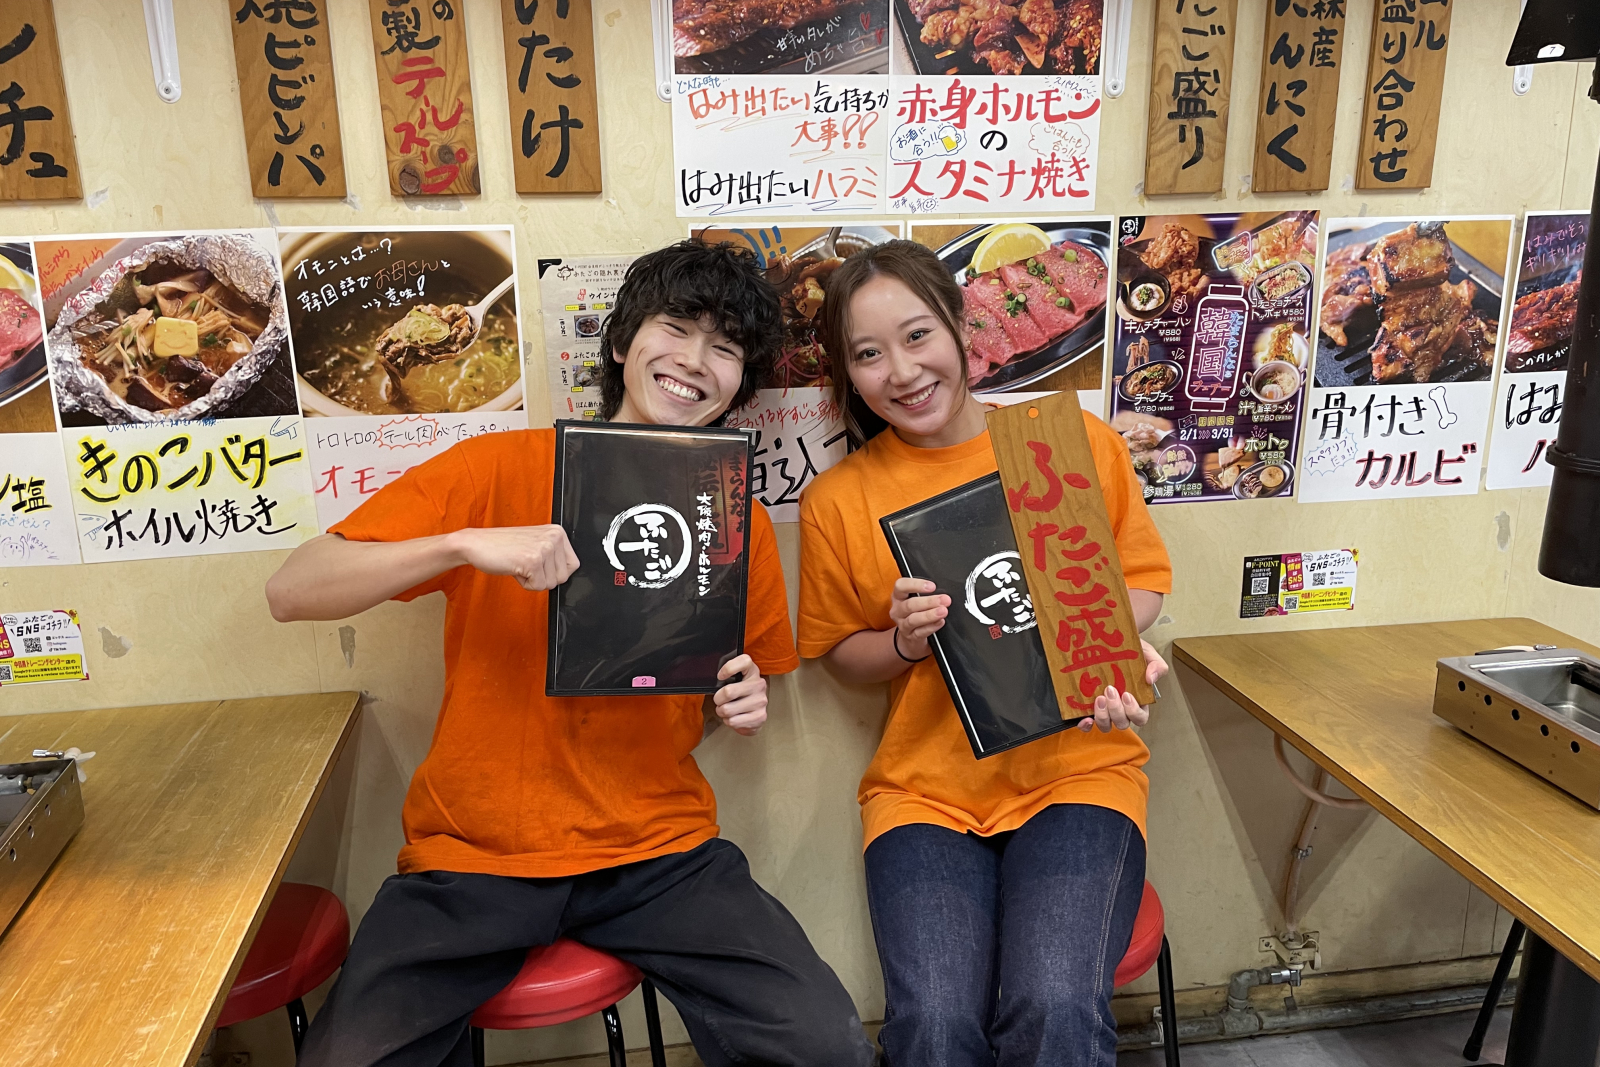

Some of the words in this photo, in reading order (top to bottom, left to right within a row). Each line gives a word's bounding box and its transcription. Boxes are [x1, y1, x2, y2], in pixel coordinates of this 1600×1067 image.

[896, 79, 1101, 130] 赤身ホルモン
[979, 130, 1008, 151] の
[888, 152, 1091, 203] スタミナ焼き
[1196, 307, 1233, 383] 韓国
[1133, 390, 1174, 406] チャプチェ
[1311, 390, 1428, 440] 骨付き
[1180, 428, 1198, 441] 2/1
[1212, 427, 1234, 440] 3/31
[80, 434, 302, 503] きのこバター
[1355, 442, 1478, 489] カルビ
[104, 494, 298, 550] ホイル焼き
[1007, 440, 1140, 712] ふたご盛り
[1287, 574, 1303, 585] SNS
[641, 677, 648, 686] 2
